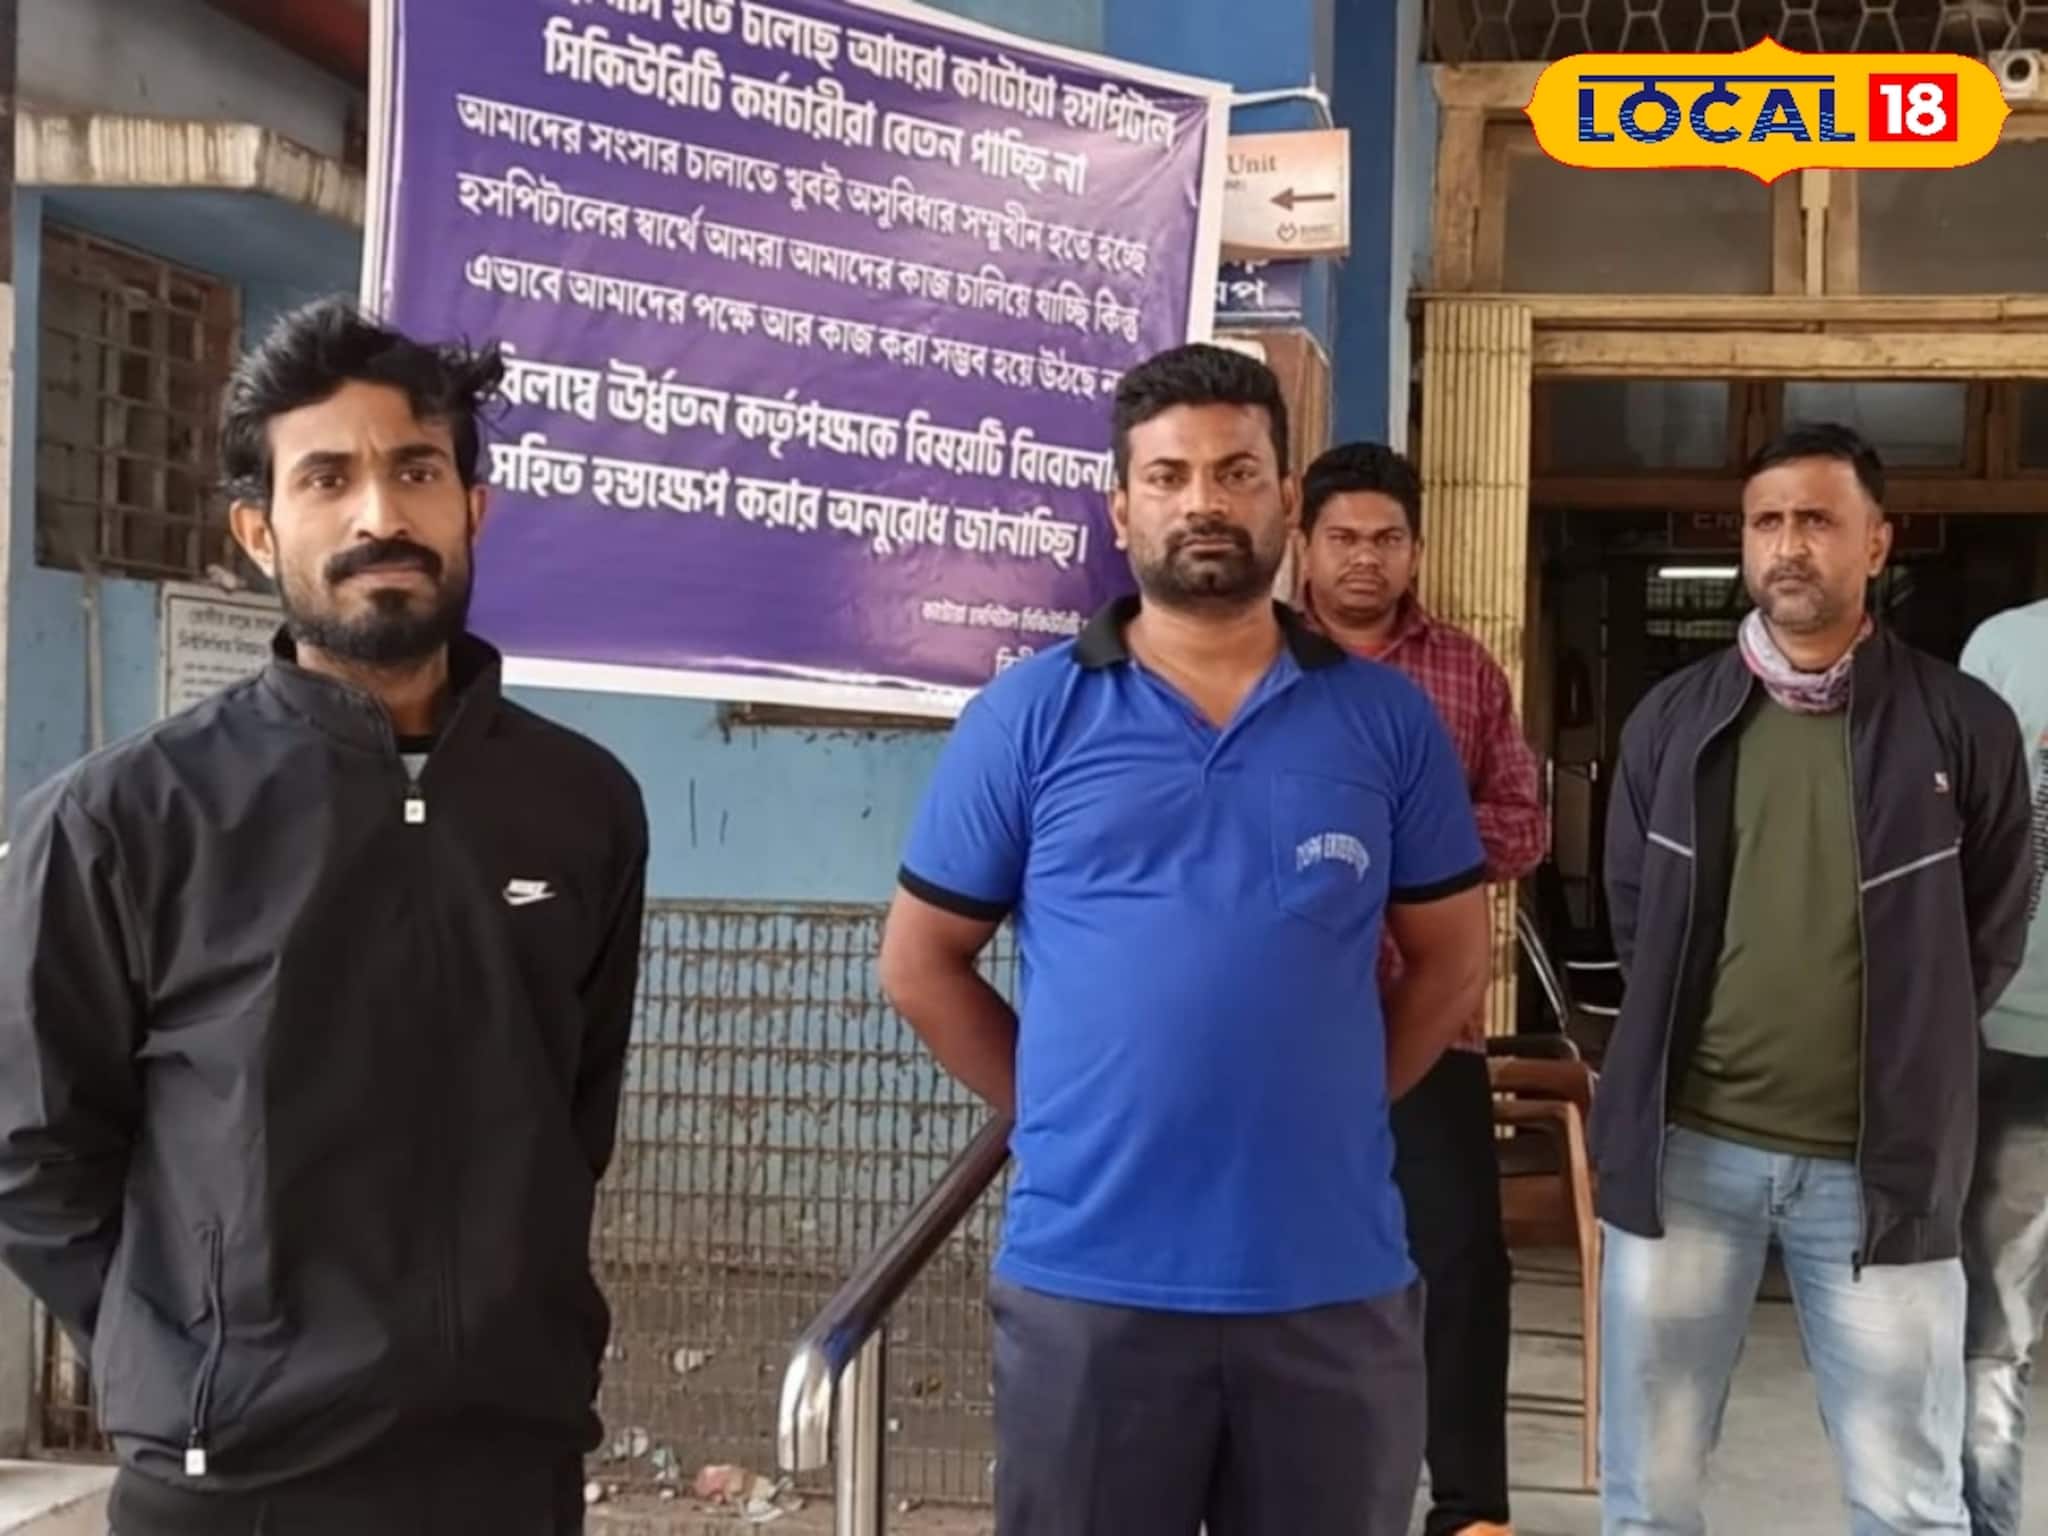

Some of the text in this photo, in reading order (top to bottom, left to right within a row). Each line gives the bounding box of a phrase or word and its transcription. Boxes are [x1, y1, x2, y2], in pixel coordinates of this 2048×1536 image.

[543, 16, 1090, 196] সিকিউরিটি কর্মচারীরা বেতন পাচ্ছি না
[741, 2, 842, 71] চলেছে
[846, 28, 947, 92] আমরা
[950, 52, 1058, 121] কাটোয়া
[1061, 83, 1178, 149] হসপিটাল
[456, 93, 585, 155] আমাদের
[588, 122, 682, 177] সংসার
[685, 143, 781, 194] চালাতে
[784, 161, 843, 211] খুবই
[846, 175, 958, 235] অসুবিধার
[1047, 222, 1094, 264] হতে
[1096, 236, 1148, 277] হচ্ছে
[1226, 154, 1277, 175] Unit
[456, 166, 1141, 345] হসপিটালের স্বার্থে আমরা আমাদের কাজ চালিয়ে যাচ্ছি কিন্তু
[464, 254, 564, 304] এভাবে
[568, 270, 689, 324] আমাদের
[692, 293, 757, 336] পক্ষে
[760, 304, 814, 346] আর
[818, 316, 877, 356] কাজ
[878, 327, 929, 367] করা
[931, 335, 993, 378] সম্ভব
[991, 355, 1035, 387] হয়ে
[1100, 367, 1125, 393] ন
[476, 341, 602, 422] বিলম্বে
[905, 409, 1007, 476] বিষয়টি
[1011, 427, 1117, 492] বিবেচনা
[487, 432, 588, 499] সহিত
[591, 456, 732, 518] হস্তক্ষেপ
[735, 476, 822, 532] করার
